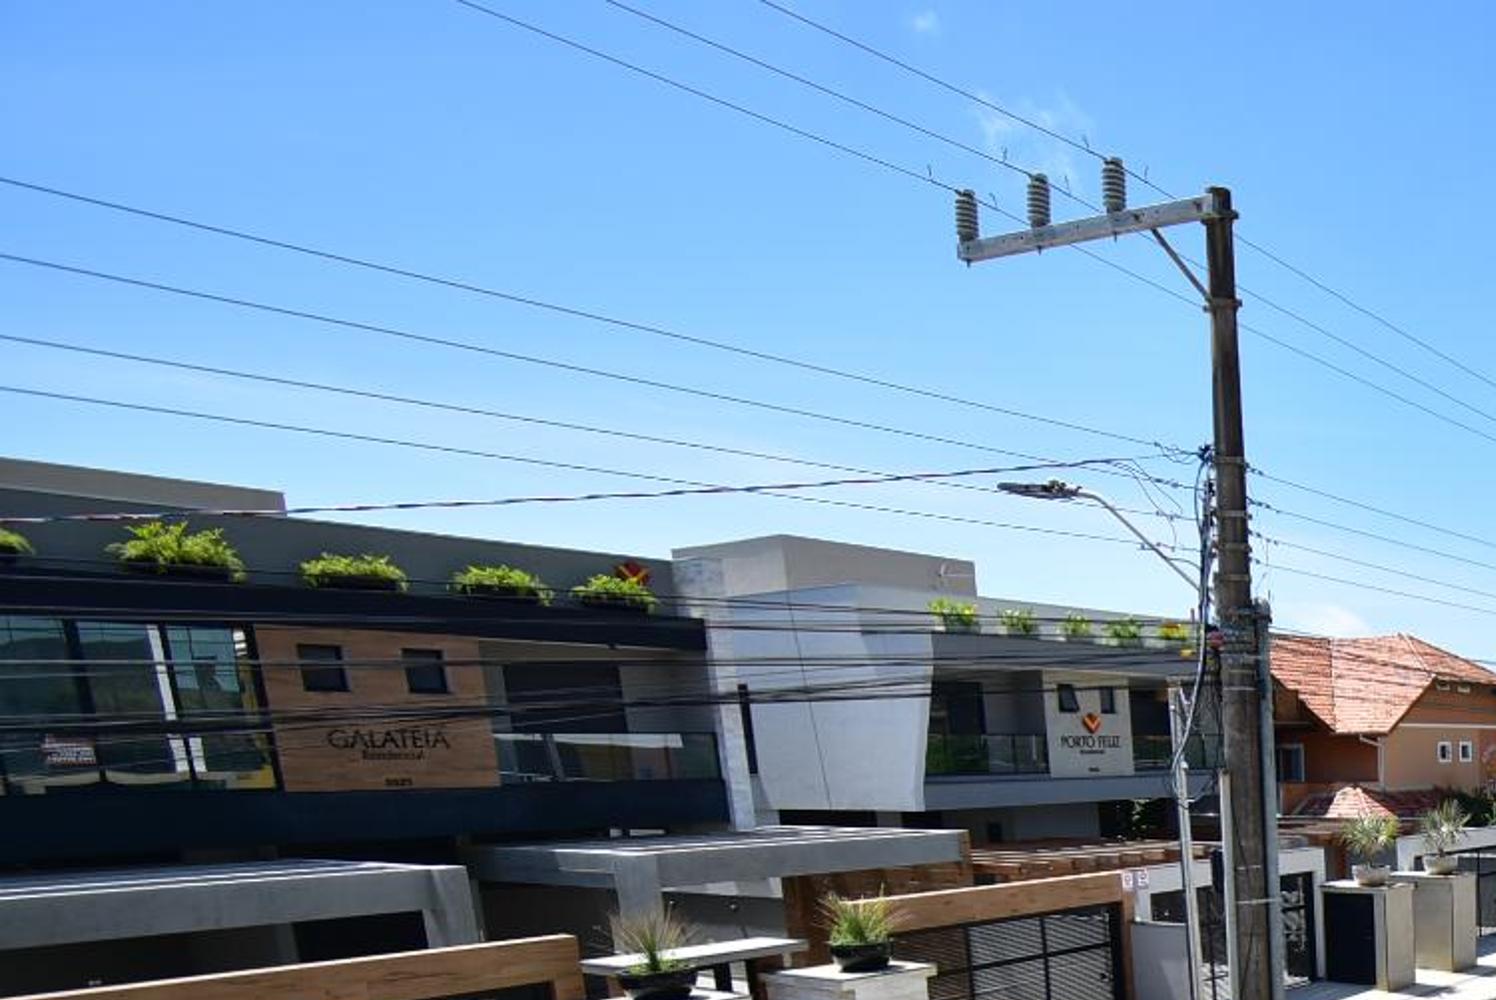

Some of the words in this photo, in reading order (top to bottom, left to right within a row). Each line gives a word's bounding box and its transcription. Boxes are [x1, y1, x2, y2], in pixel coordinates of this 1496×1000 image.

[327, 728, 452, 749] GALATEIA
[1061, 734, 1096, 748] PORTO
[1097, 734, 1121, 748] FELIZ
